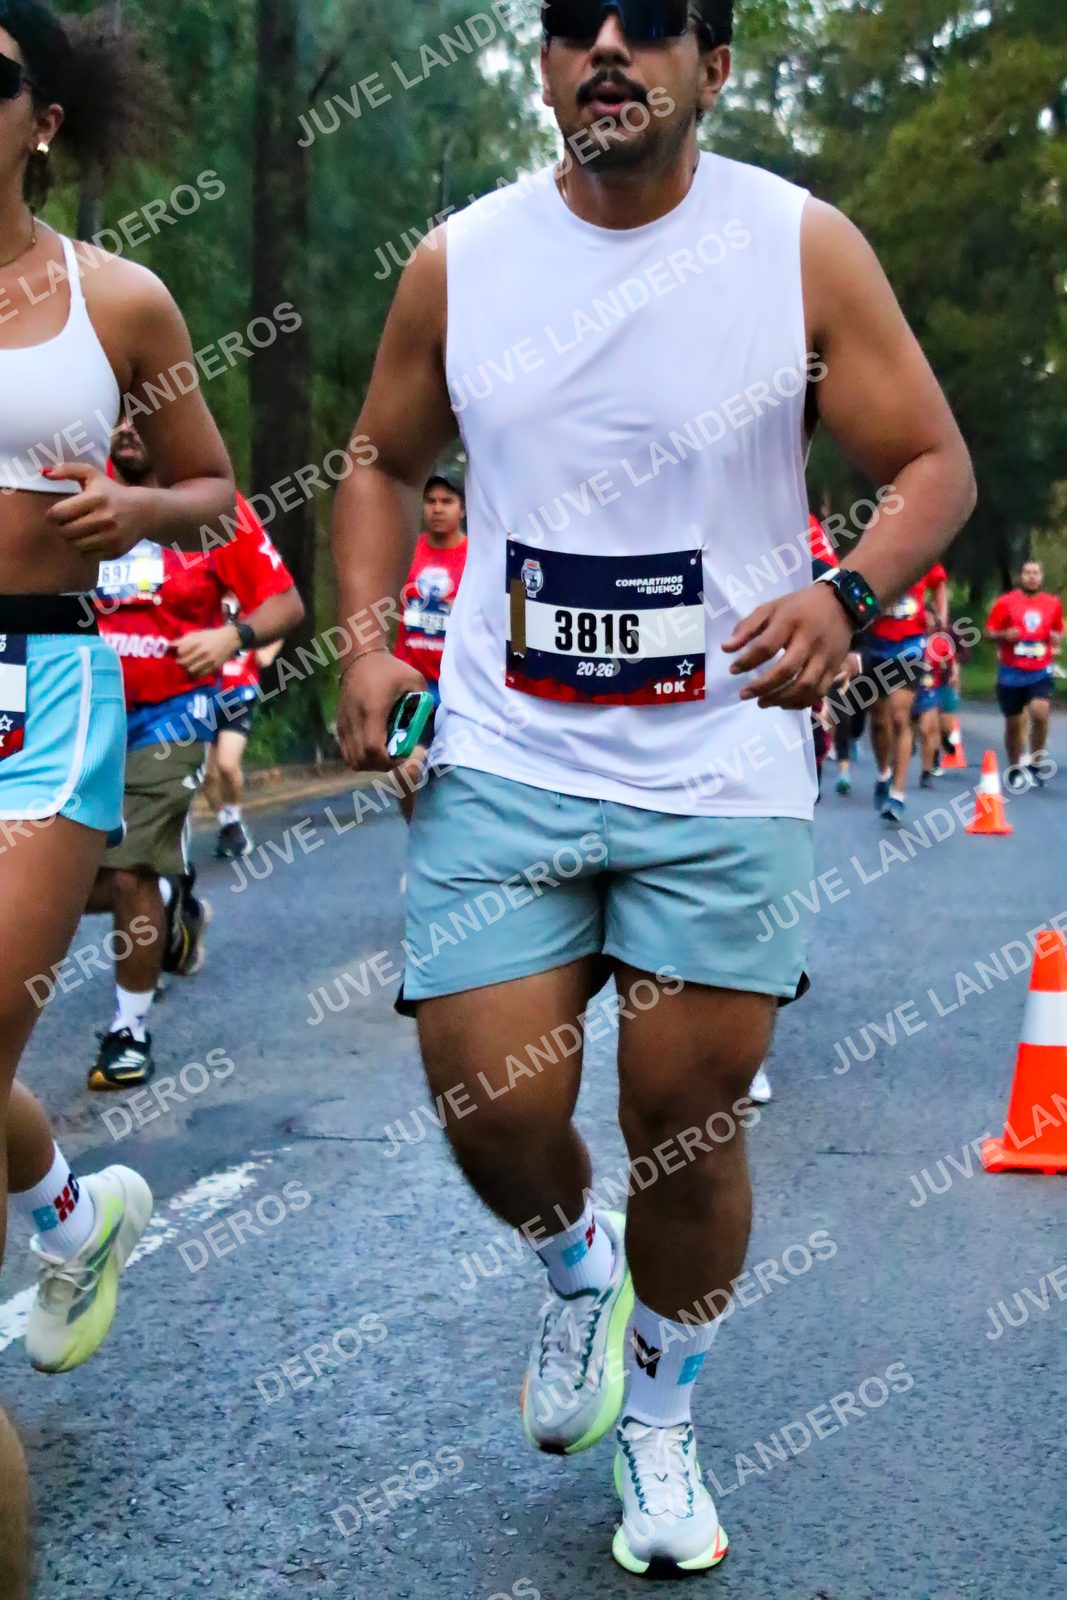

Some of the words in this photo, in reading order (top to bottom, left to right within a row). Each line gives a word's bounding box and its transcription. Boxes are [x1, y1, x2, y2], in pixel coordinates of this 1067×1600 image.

[615, 575, 683, 587] COMPARTIMOS
[554, 610, 640, 655] 3816
[653, 680, 686, 695] 10K
